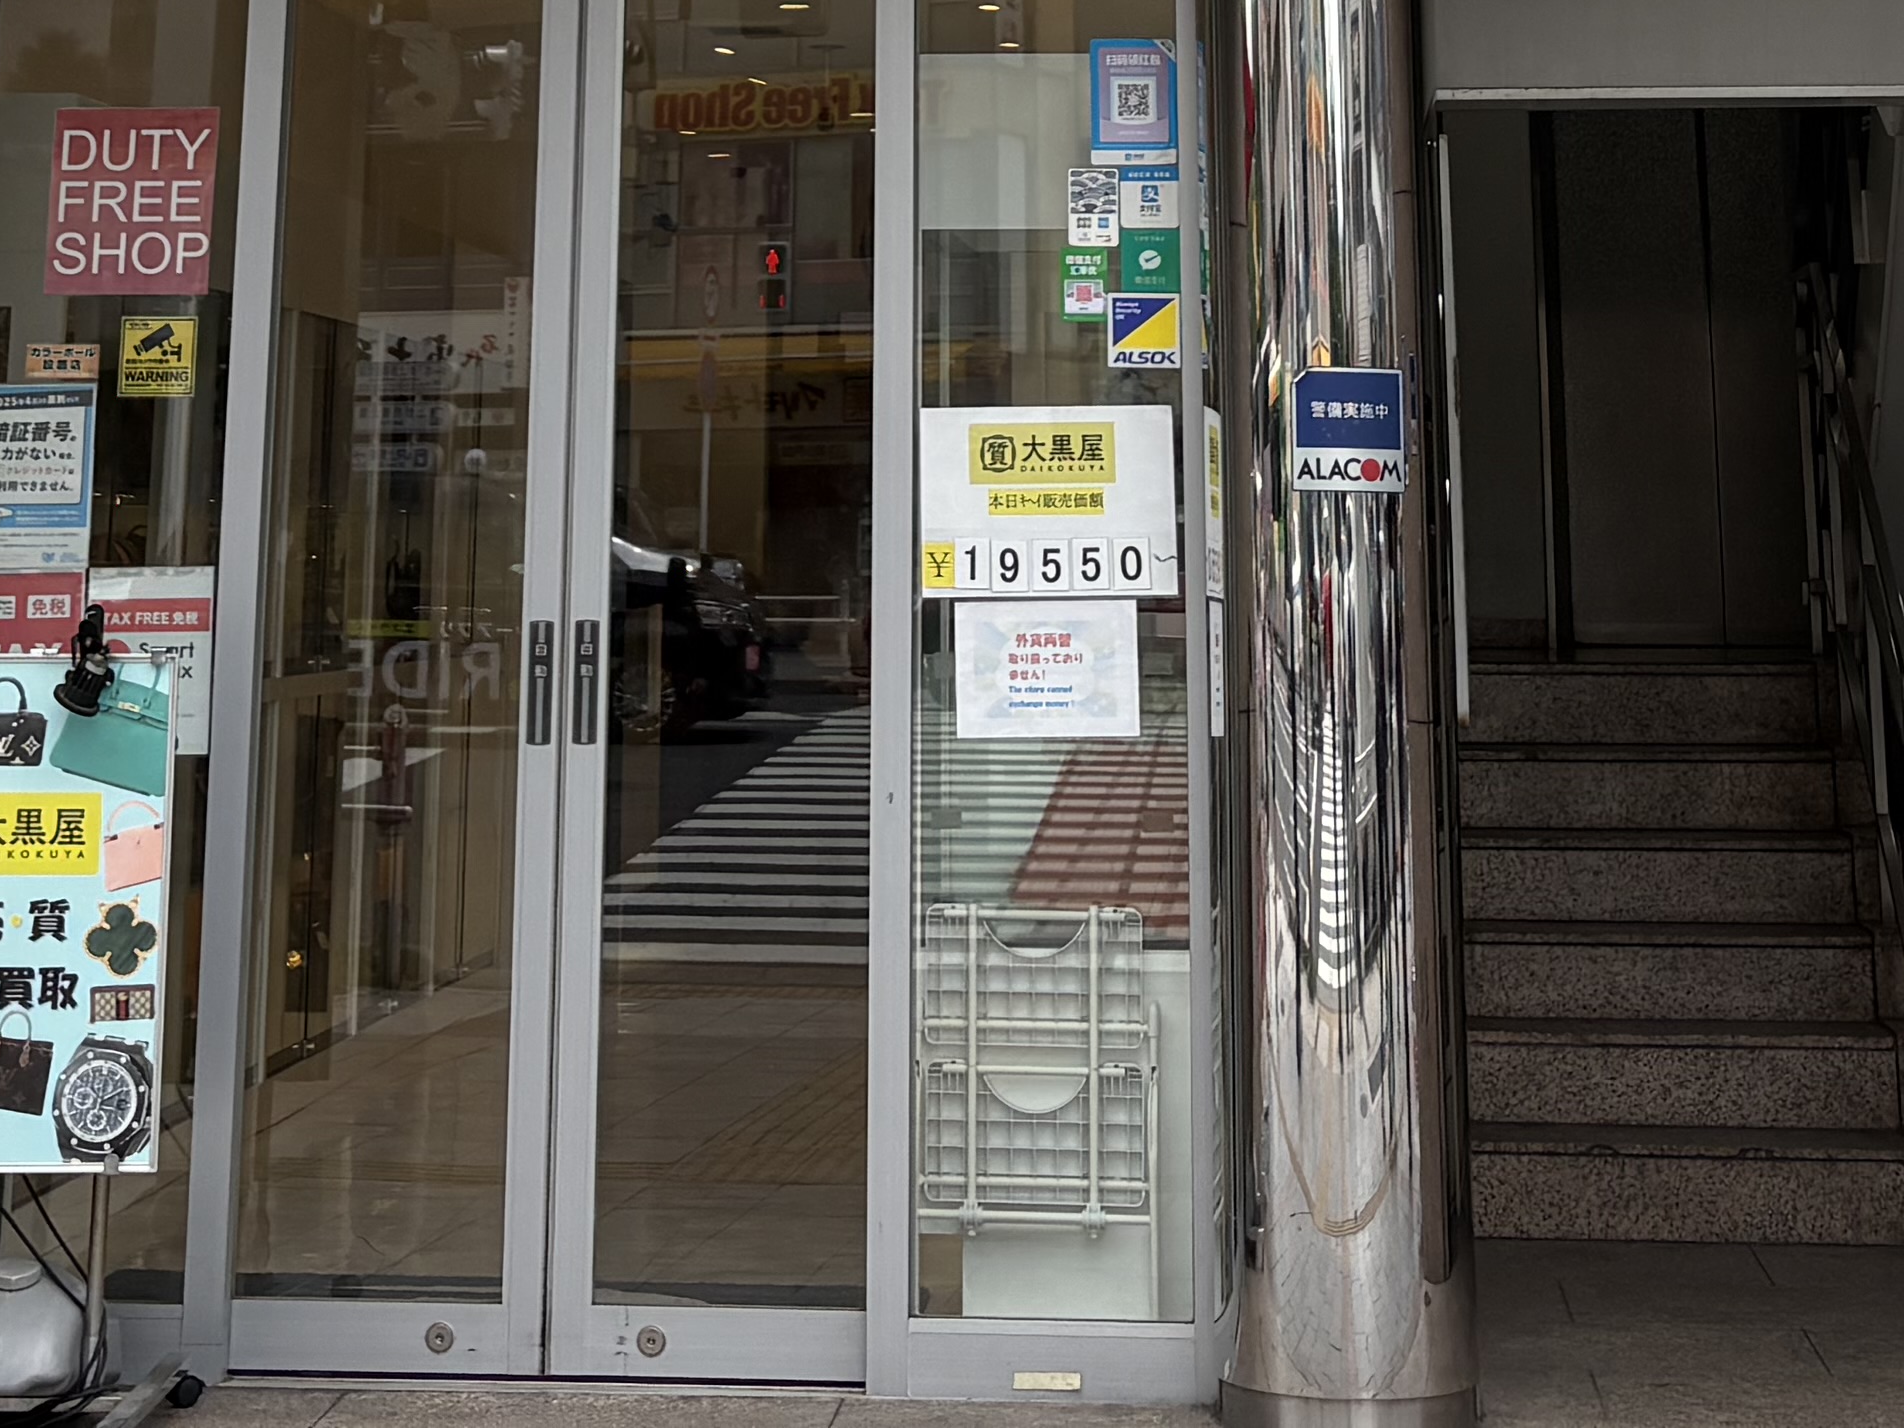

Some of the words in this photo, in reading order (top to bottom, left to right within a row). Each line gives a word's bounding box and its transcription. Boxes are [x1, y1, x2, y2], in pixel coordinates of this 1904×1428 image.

[60, 128, 212, 172] DUTY
[57, 179, 203, 224] FREE
[52, 231, 210, 275] SHOP
[1113, 351, 1177, 365] ALSOK
[125, 370, 189, 383] WARNING
[1309, 400, 1389, 420] 警備実施中
[1021, 433, 1106, 463] 大黒屋
[1020, 464, 1106, 473] DAIKOKUYA
[1296, 457, 1402, 483] ALACOM
[31, 597, 66, 617] 免税
[104, 611, 132, 626] TAX
[134, 610, 170, 625] FREE
